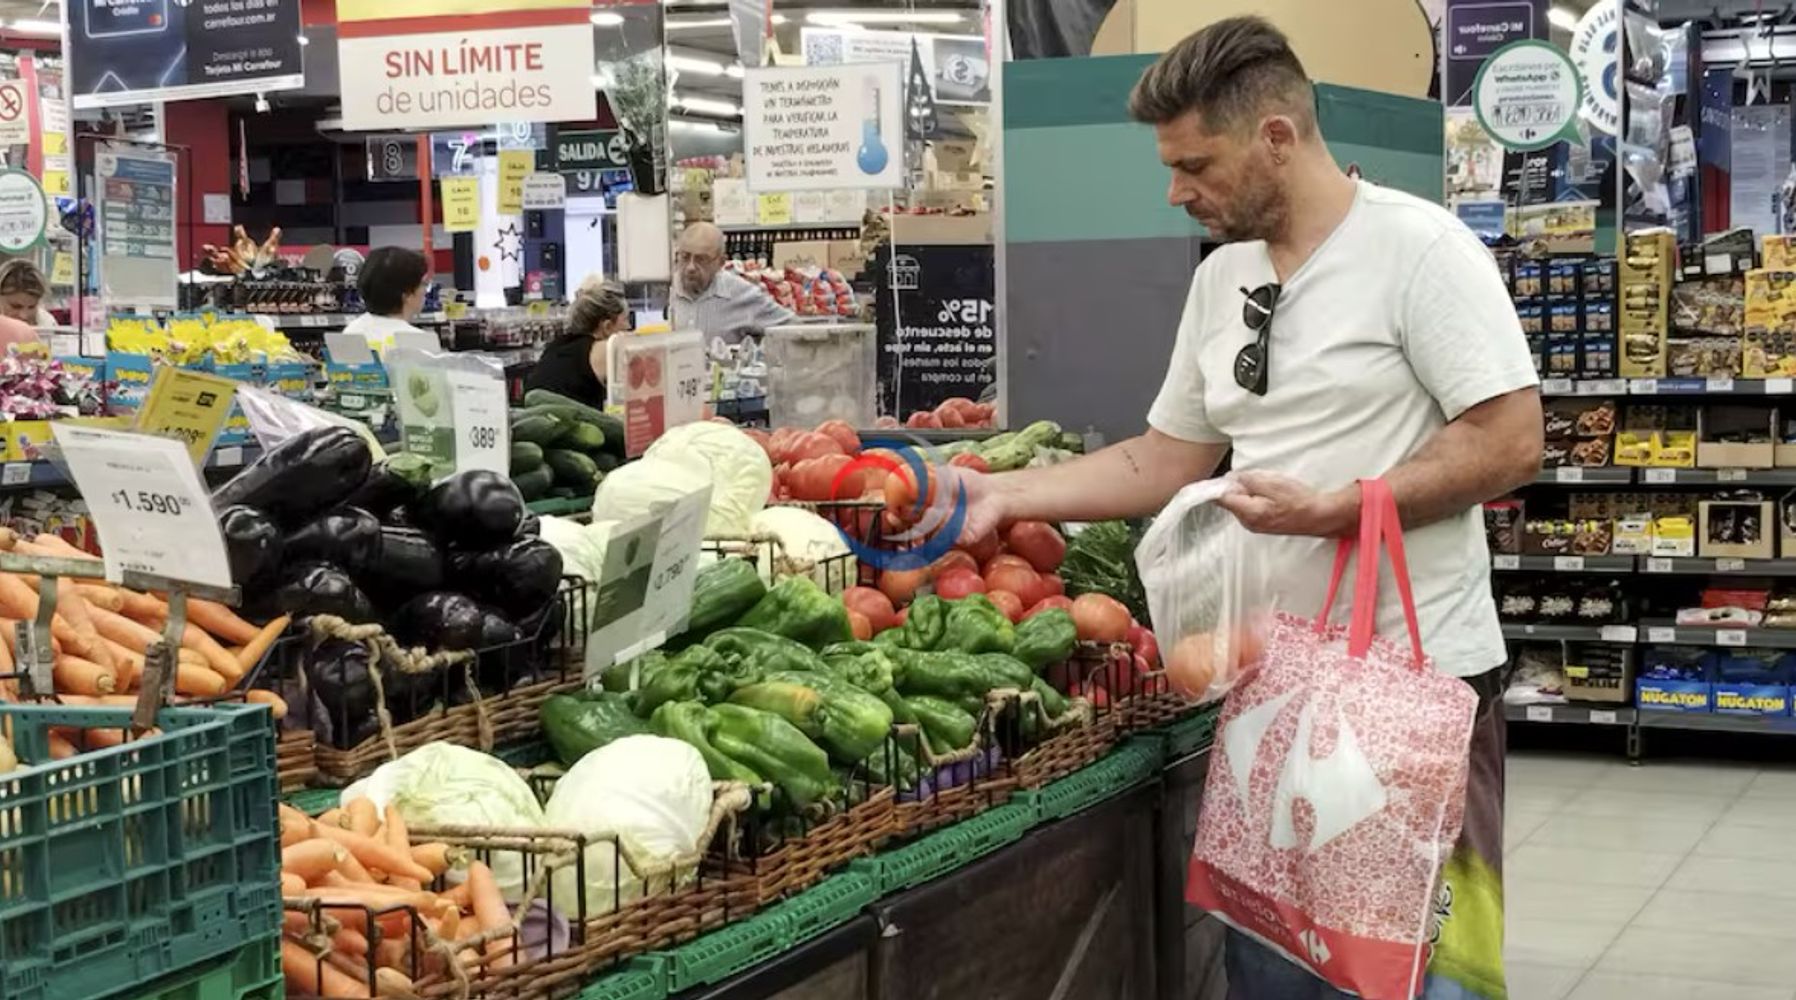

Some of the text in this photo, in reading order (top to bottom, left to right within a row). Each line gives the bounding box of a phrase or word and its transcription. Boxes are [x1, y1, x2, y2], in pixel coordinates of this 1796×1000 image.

[204, 13, 277, 30] carrefour.com.ar
[244, 59, 283, 72] Carrefour
[385, 38, 545, 78] SIN LÍMITE
[376, 77, 553, 115] de unidades
[772, 127, 829, 139] TEMPERATURA
[382, 140, 404, 176] 8
[448, 139, 470, 172] 7
[558, 142, 607, 162] SALIDA
[1640, 690, 1708, 706] NUGATON
[1716, 695, 1785, 711] NUGATON
